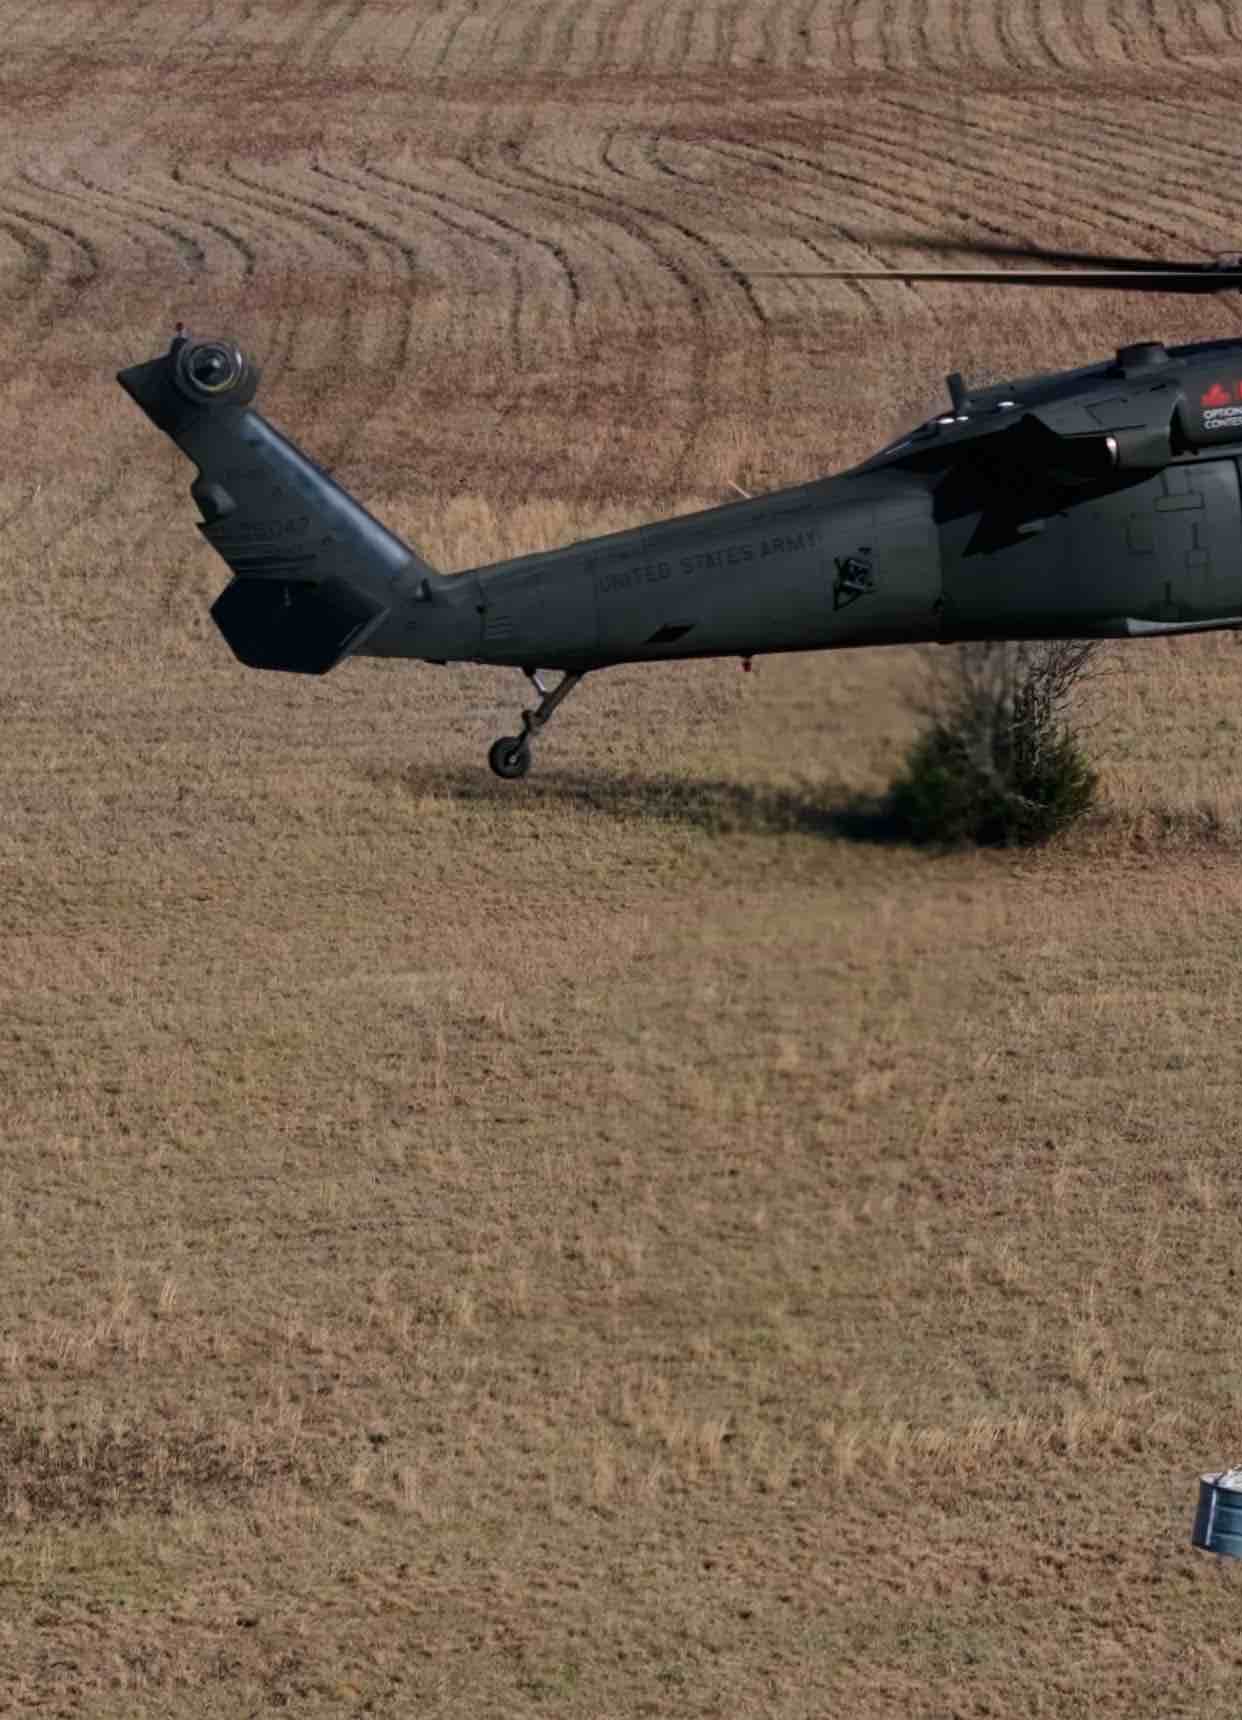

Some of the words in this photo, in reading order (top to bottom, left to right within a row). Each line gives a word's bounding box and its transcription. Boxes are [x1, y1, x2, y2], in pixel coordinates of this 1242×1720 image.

[600, 561, 671, 593] UNITED
[680, 545, 752, 576] STATES
[760, 529, 818, 559] ARMY
